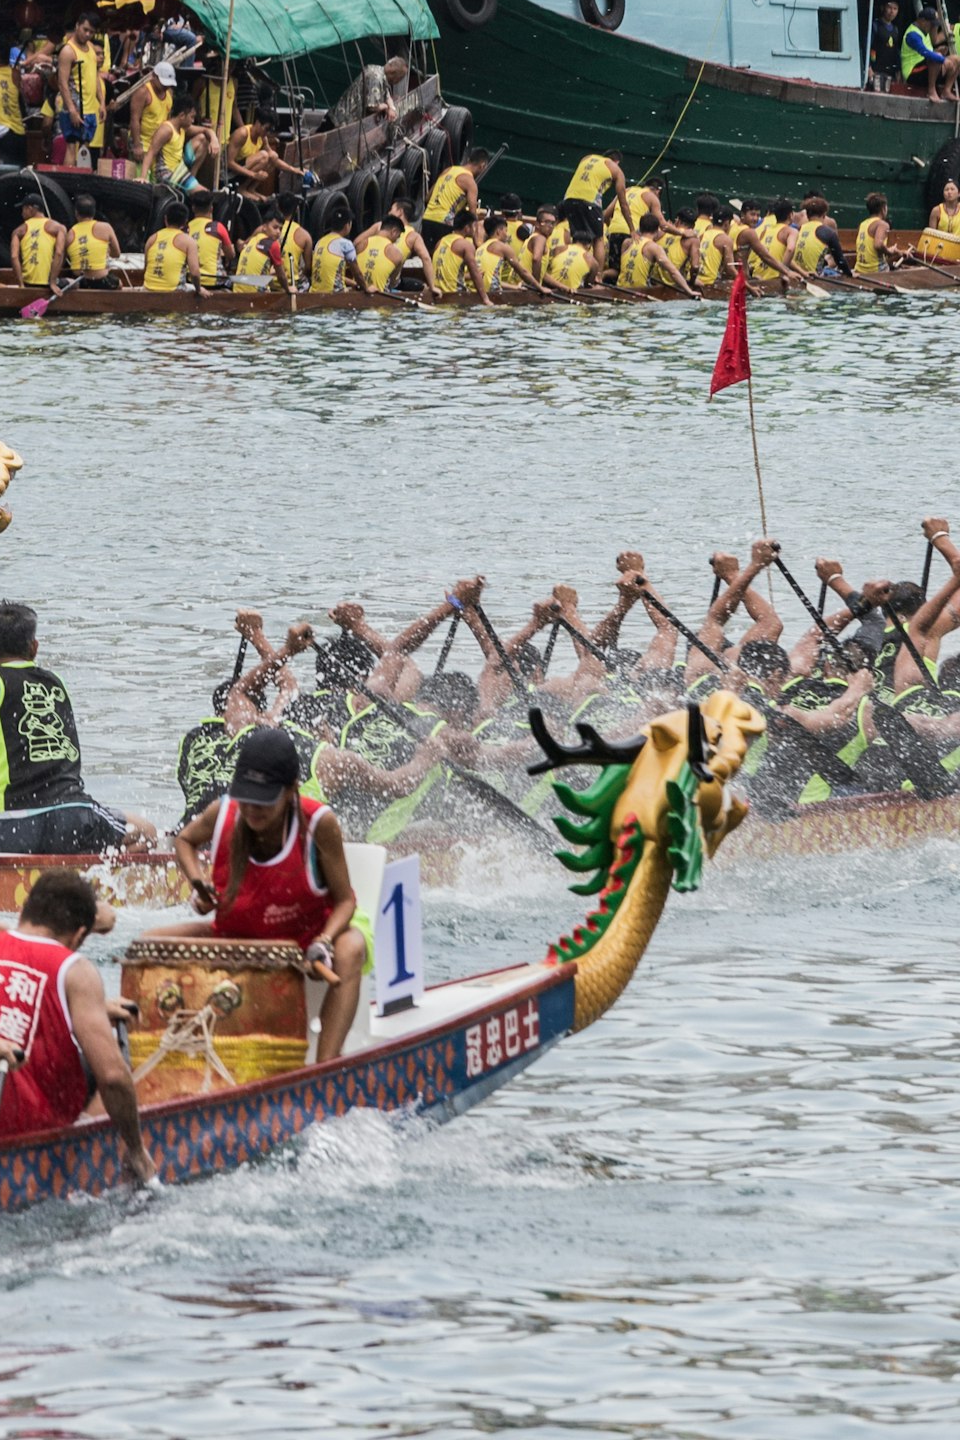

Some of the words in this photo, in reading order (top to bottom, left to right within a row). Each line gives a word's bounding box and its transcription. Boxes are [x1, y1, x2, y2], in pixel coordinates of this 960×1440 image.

[382, 882, 415, 987] 1
[465, 998, 539, 1079] 冠忠巴士
